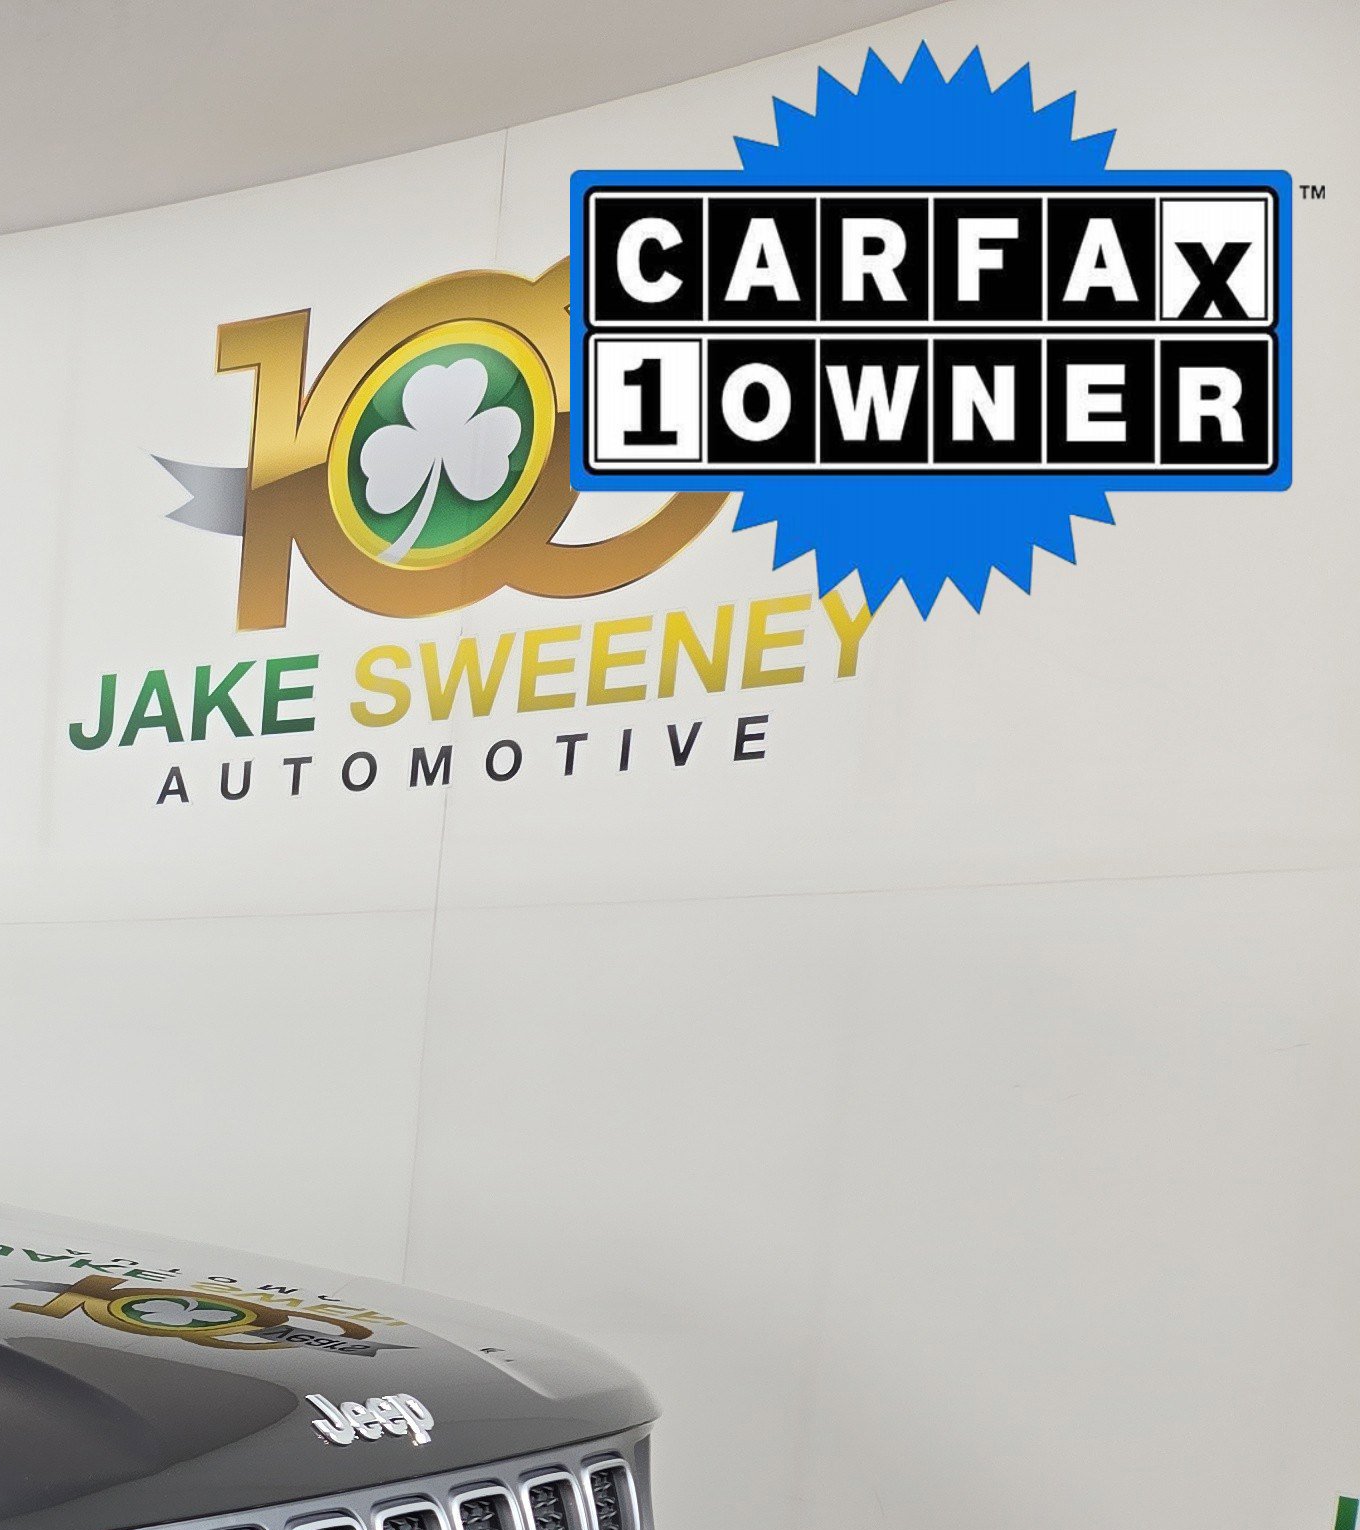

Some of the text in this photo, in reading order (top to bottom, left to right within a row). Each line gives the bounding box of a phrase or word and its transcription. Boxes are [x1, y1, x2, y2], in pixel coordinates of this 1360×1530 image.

[68, 592, 880, 751] JAKE SWEENEY
[156, 714, 770, 805] AUTOMOTIVE
[305, 1393, 435, 1446] Jeep
